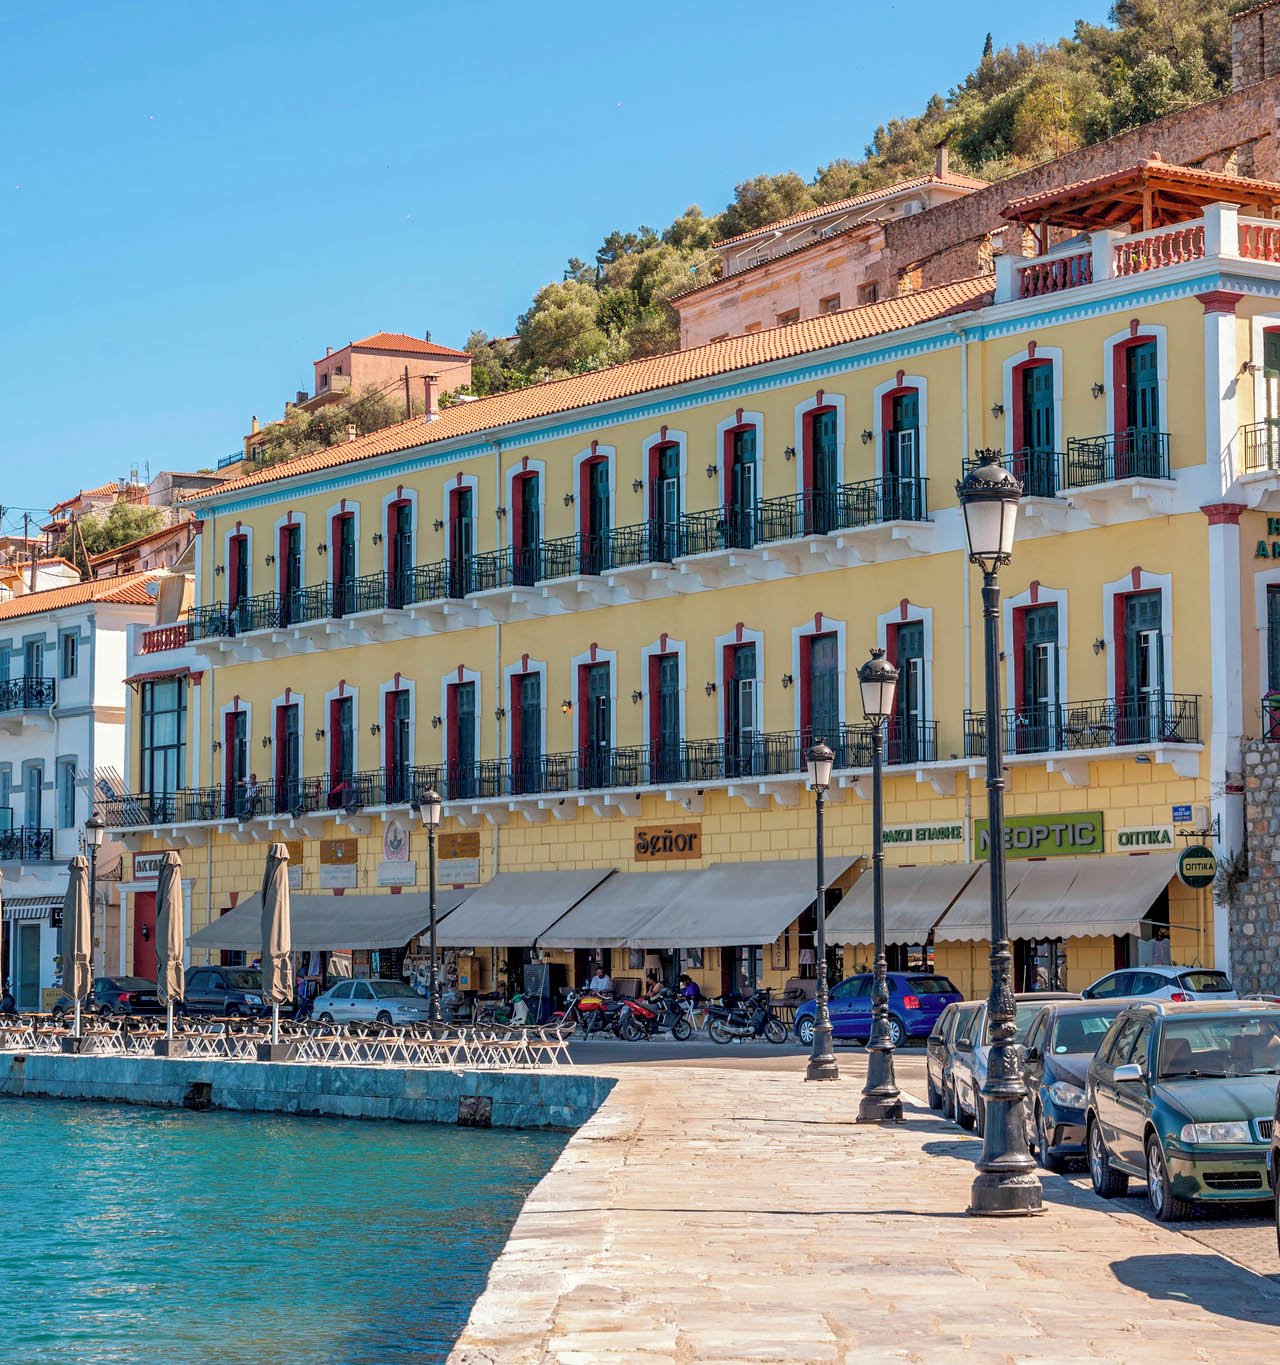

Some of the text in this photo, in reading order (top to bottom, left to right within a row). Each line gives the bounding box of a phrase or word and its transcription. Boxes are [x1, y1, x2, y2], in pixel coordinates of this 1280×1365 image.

[636, 829, 697, 856] Señor
[979, 823, 1095, 851] NEOPTIC
[1118, 829, 1172, 846] ΟΠΤΙΚΑ
[1185, 863, 1214, 871] ΟΠΤΙΚΑ
